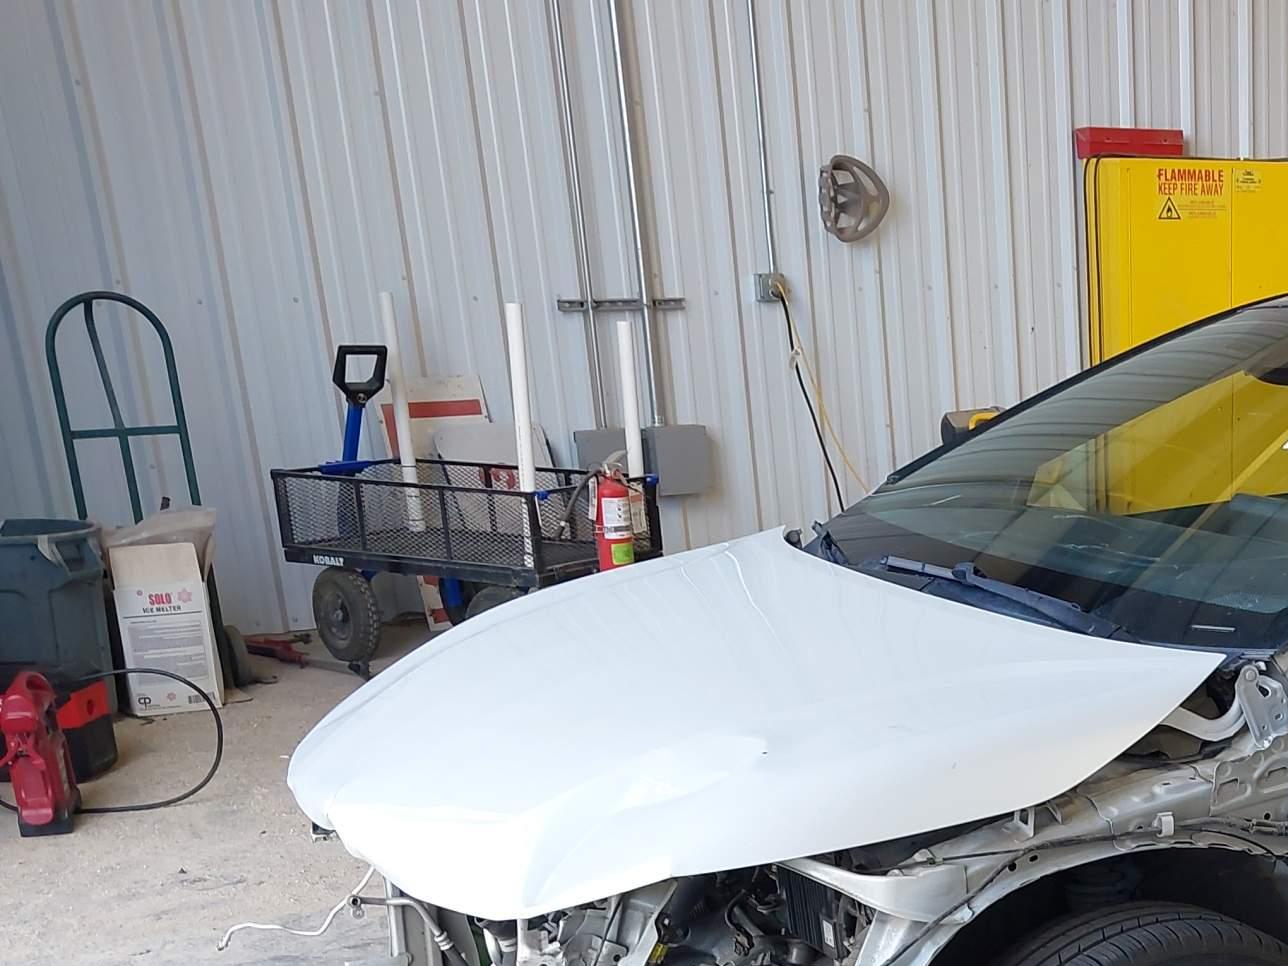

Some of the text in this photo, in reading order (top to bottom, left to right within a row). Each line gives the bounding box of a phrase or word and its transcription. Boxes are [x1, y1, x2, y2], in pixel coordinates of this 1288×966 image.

[1157, 168, 1224, 183] FLAMMABLE
[1158, 182, 1224, 197] KEEP FIRE AWAY
[312, 554, 345, 567] KOBALT
[148, 592, 172, 606] SOLO
[156, 604, 182, 613] MELTER
